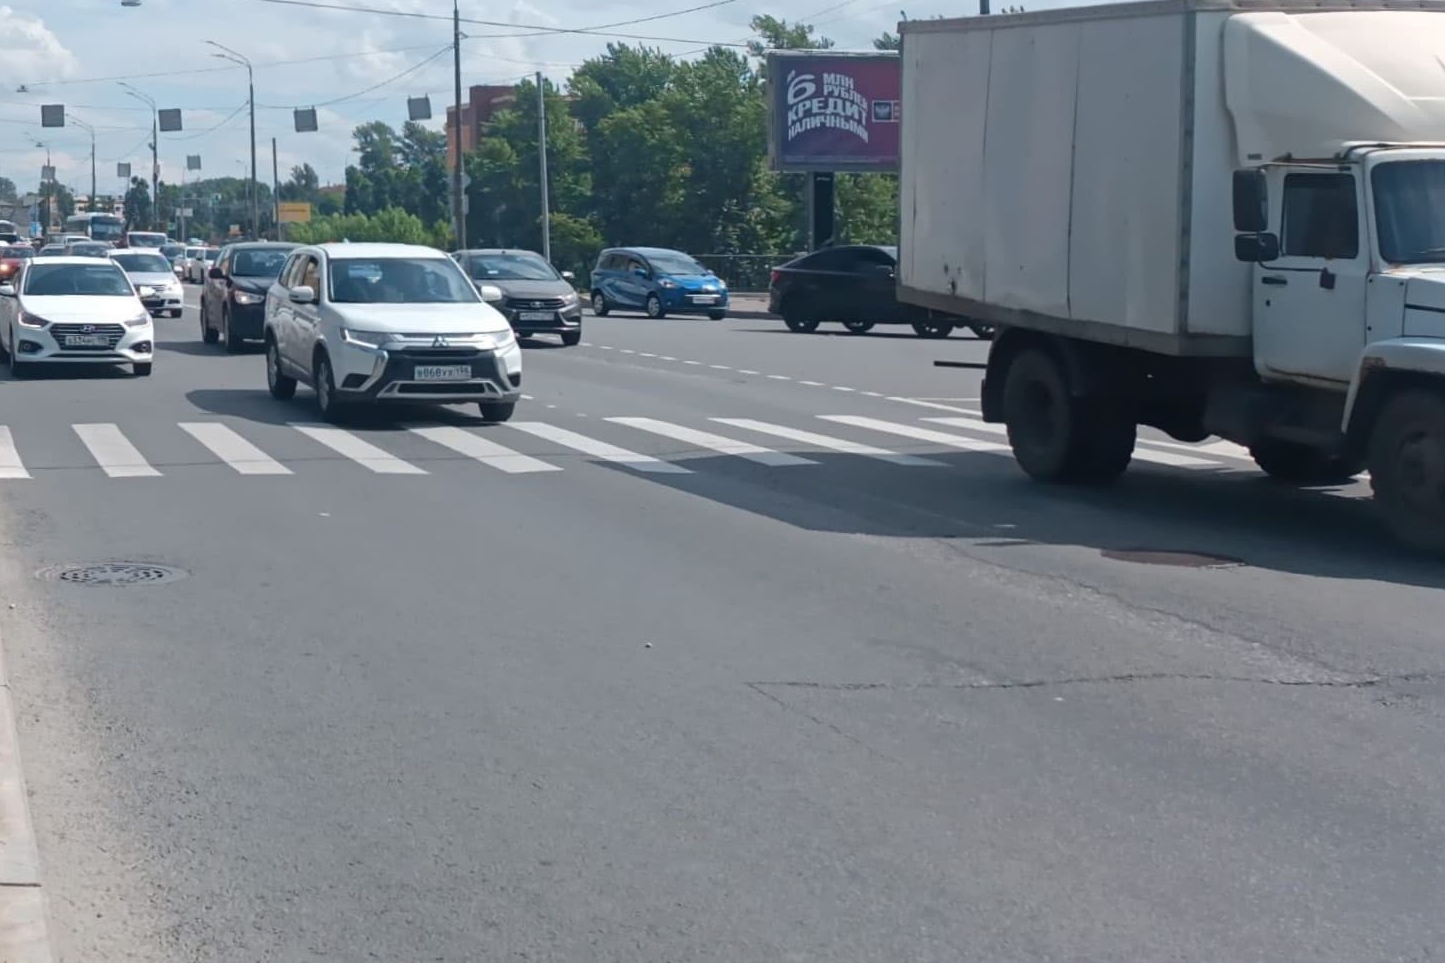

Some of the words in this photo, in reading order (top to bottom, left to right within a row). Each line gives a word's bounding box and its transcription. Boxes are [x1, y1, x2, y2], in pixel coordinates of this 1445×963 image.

[822, 72, 854, 89] МЛН
[787, 97, 868, 126] КРЕДИТ
[823, 84, 868, 113] РУБЛЕЙ
[788, 115, 869, 143] НАЛИЧНЫМИ
